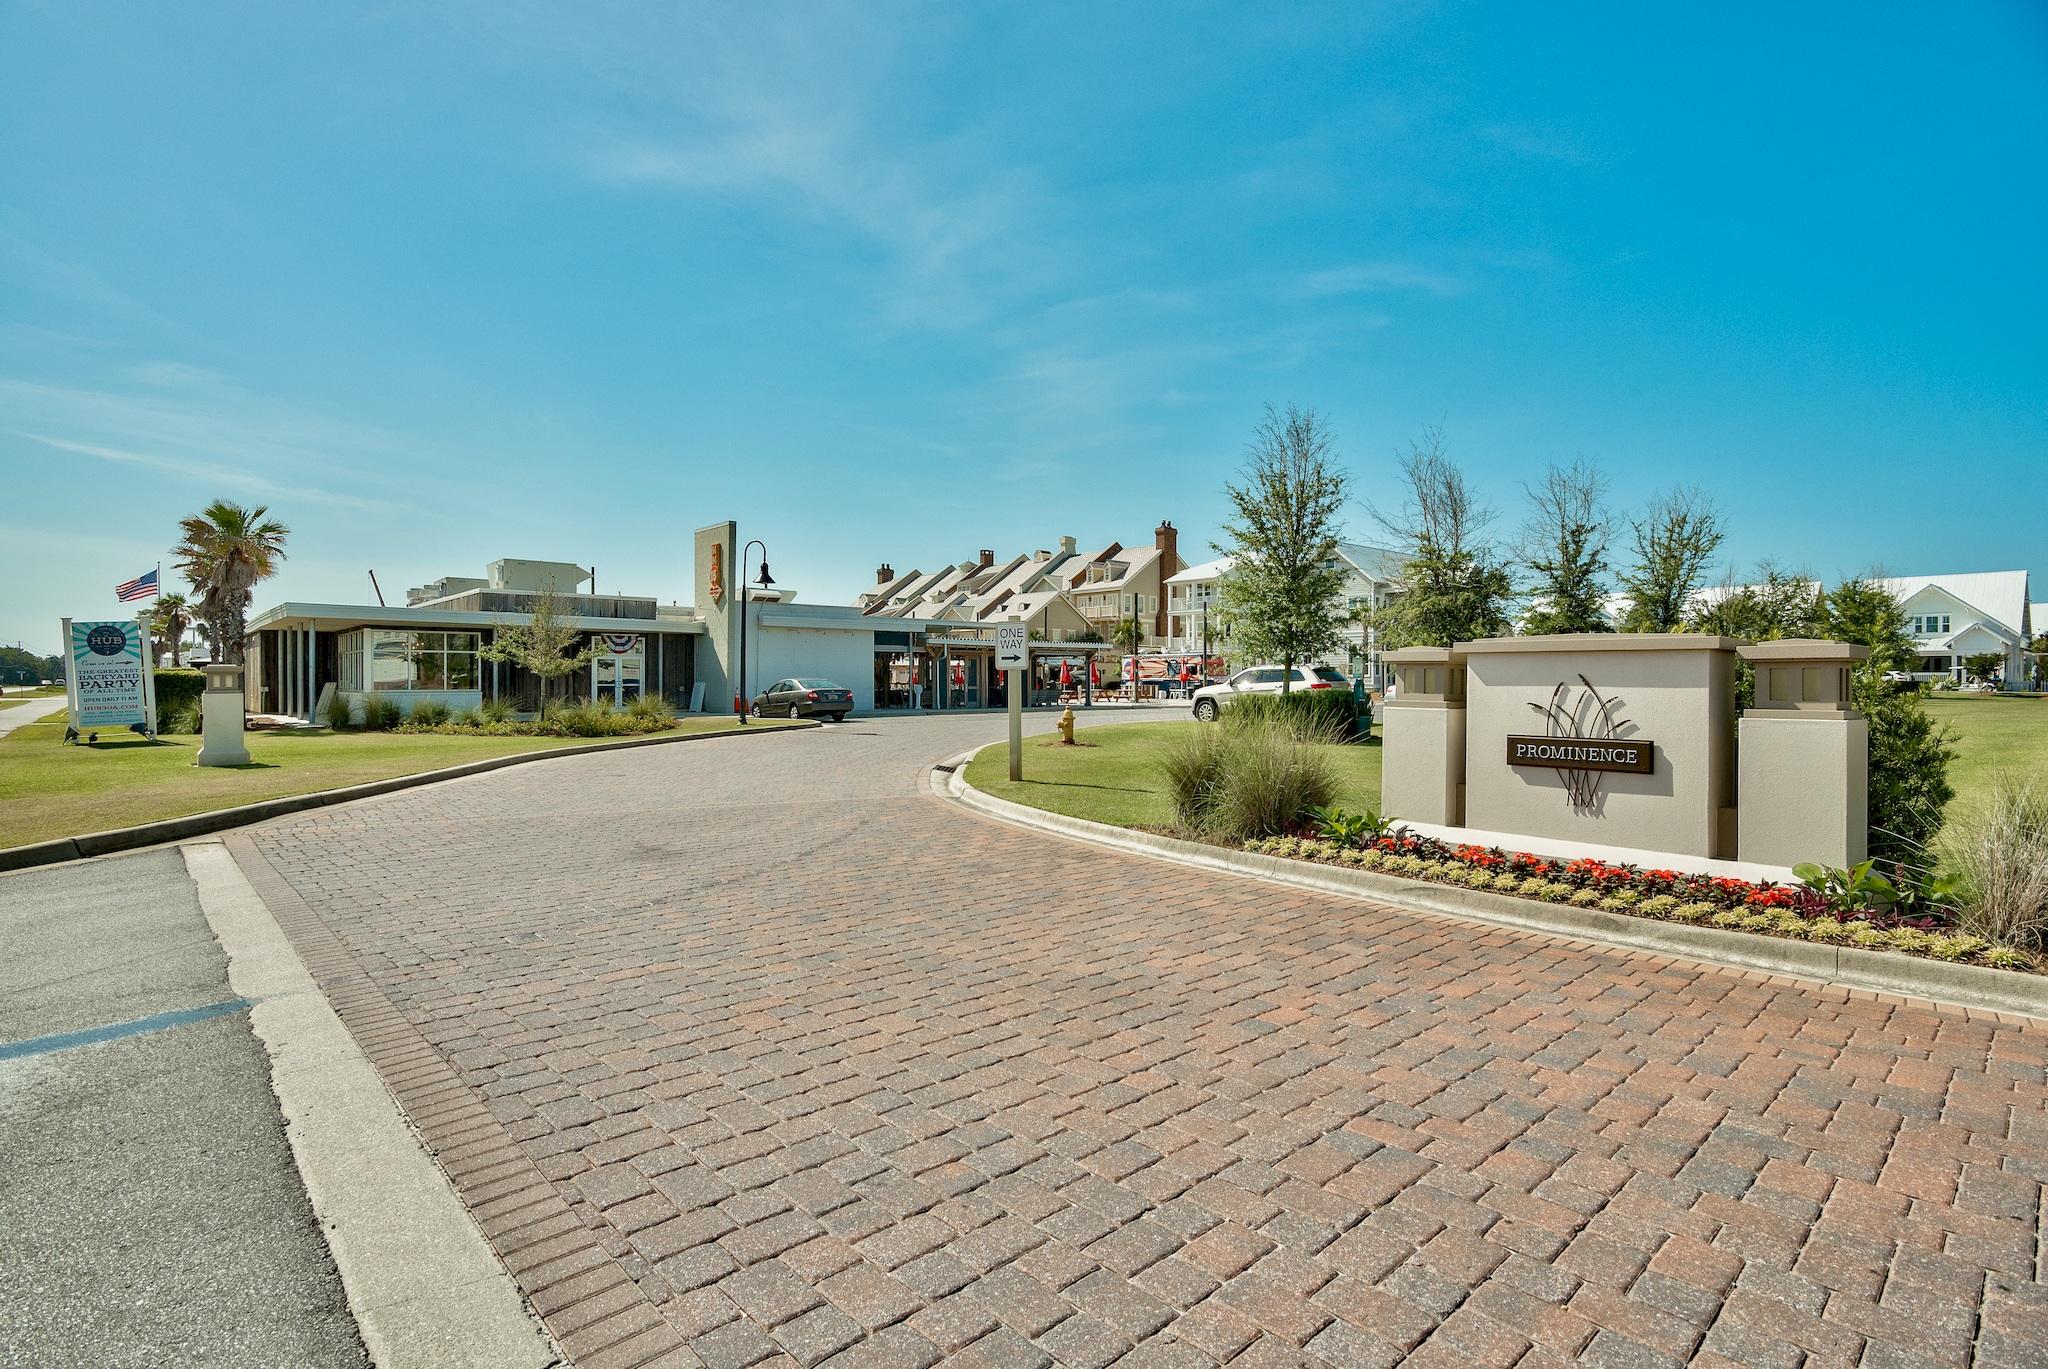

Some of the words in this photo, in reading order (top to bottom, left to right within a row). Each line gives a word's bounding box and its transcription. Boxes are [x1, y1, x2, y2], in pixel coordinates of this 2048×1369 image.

[1000, 627, 1024, 638] ONE
[91, 636, 123, 645] HUB
[1000, 639, 1023, 649] WAY
[80, 680, 139, 689] PARTY
[1516, 743, 1638, 764] PROMINENCE
